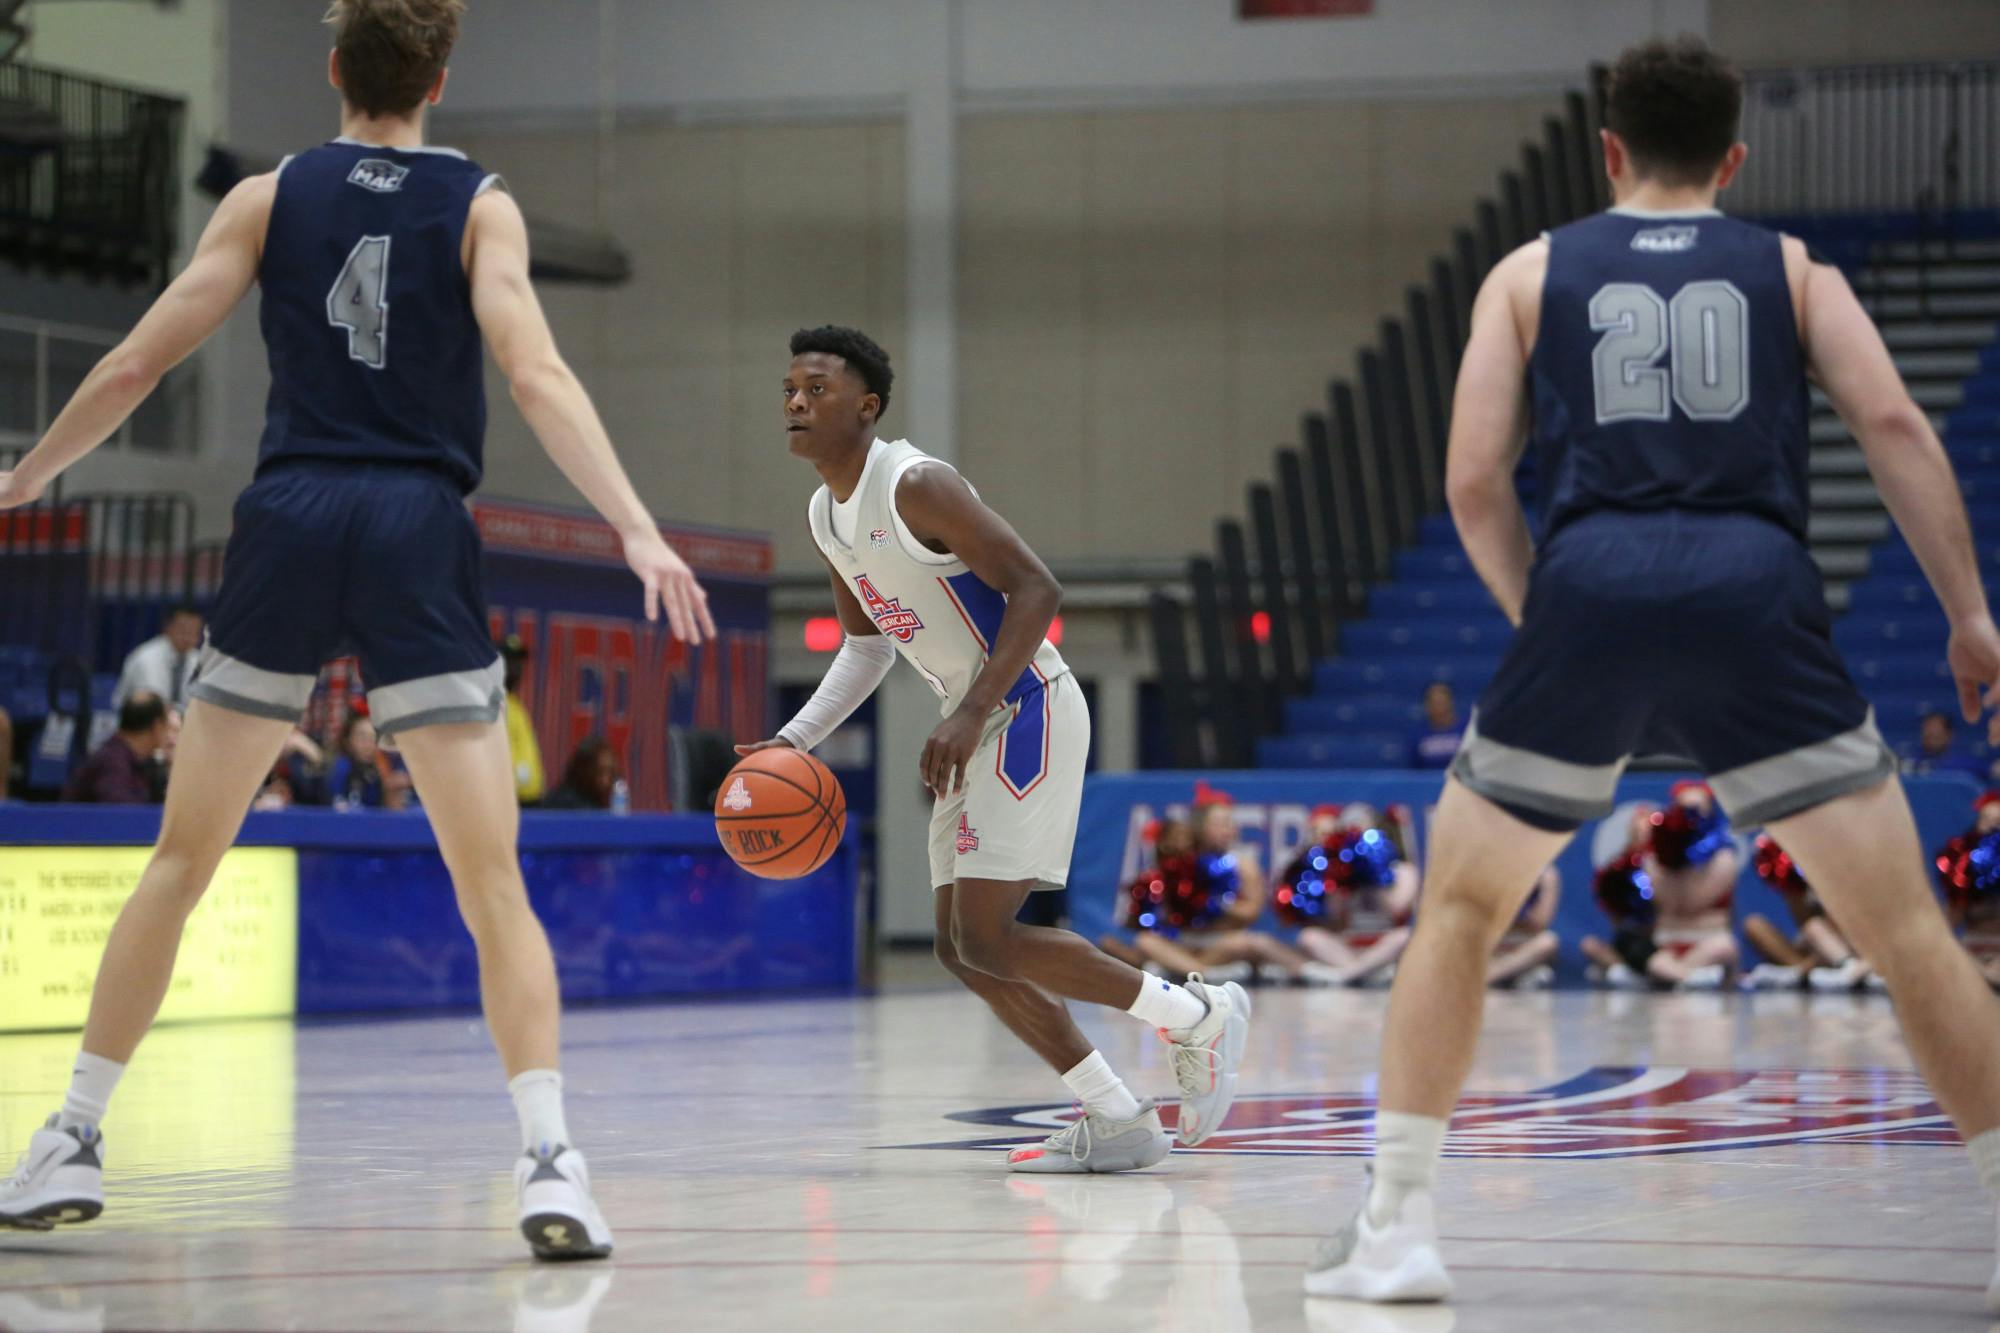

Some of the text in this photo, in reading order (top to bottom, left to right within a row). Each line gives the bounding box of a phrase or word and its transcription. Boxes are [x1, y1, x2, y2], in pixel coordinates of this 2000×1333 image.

[353, 167, 400, 189] MAC
[326, 234, 391, 369] 4
[1588, 279, 1750, 424] 20
[737, 829, 783, 854] ROCK
